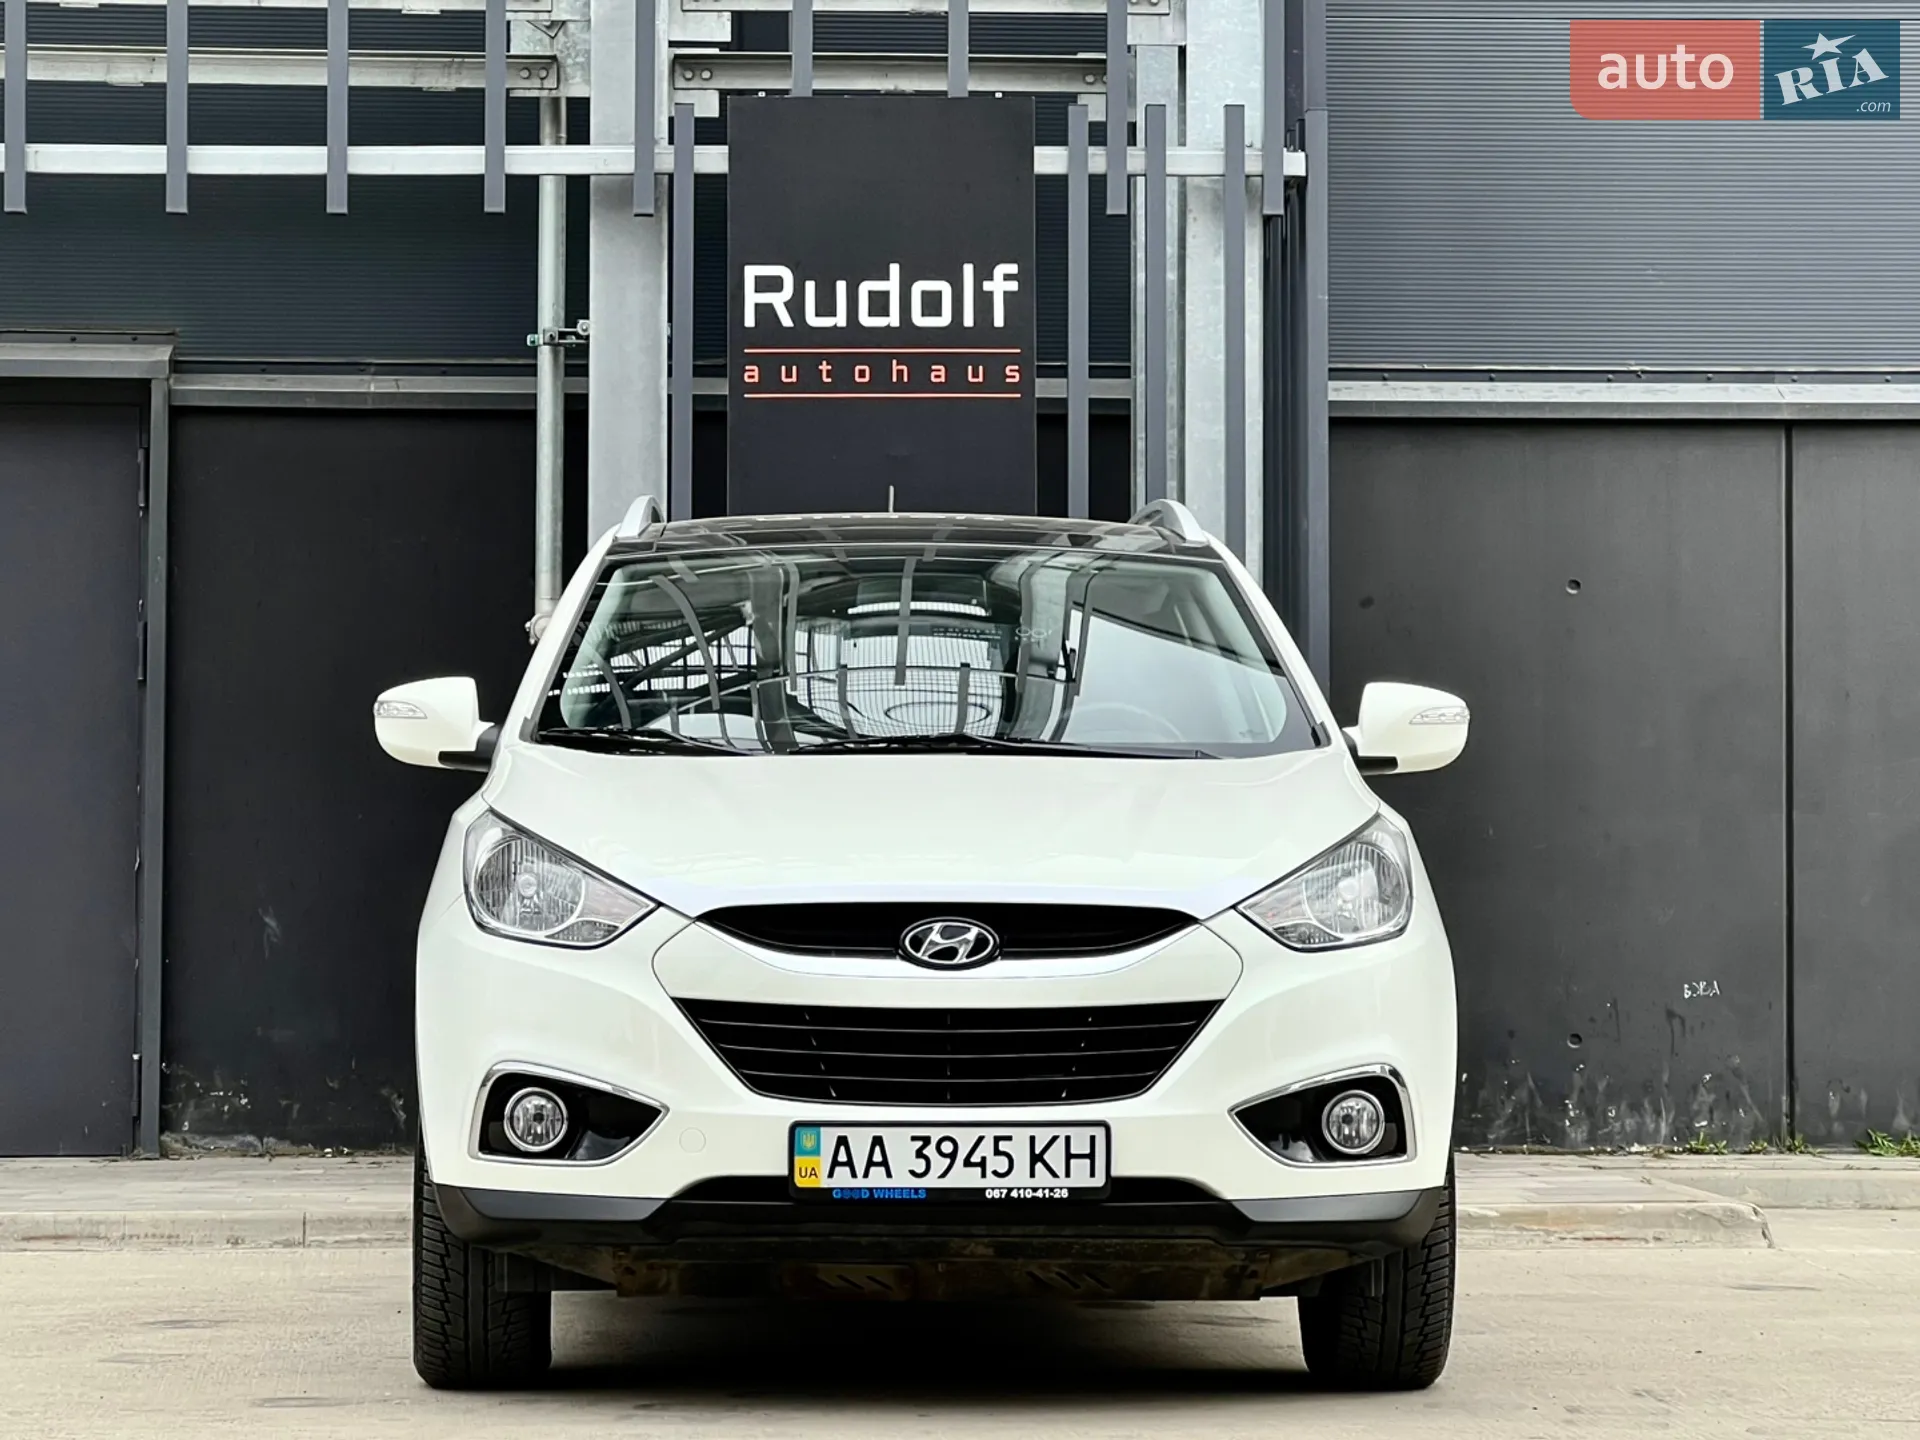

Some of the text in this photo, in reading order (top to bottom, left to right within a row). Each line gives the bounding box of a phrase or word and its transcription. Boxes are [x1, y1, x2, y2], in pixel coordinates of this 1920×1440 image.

[744, 263, 1019, 328] Rudolf
[744, 359, 1020, 383] autohaus
[827, 1135, 1096, 1179] AA 3945 KH
[799, 1166, 818, 1179] UA
[832, 1188, 870, 1199] GOOD
[873, 1188, 927, 1199] WHEELS
